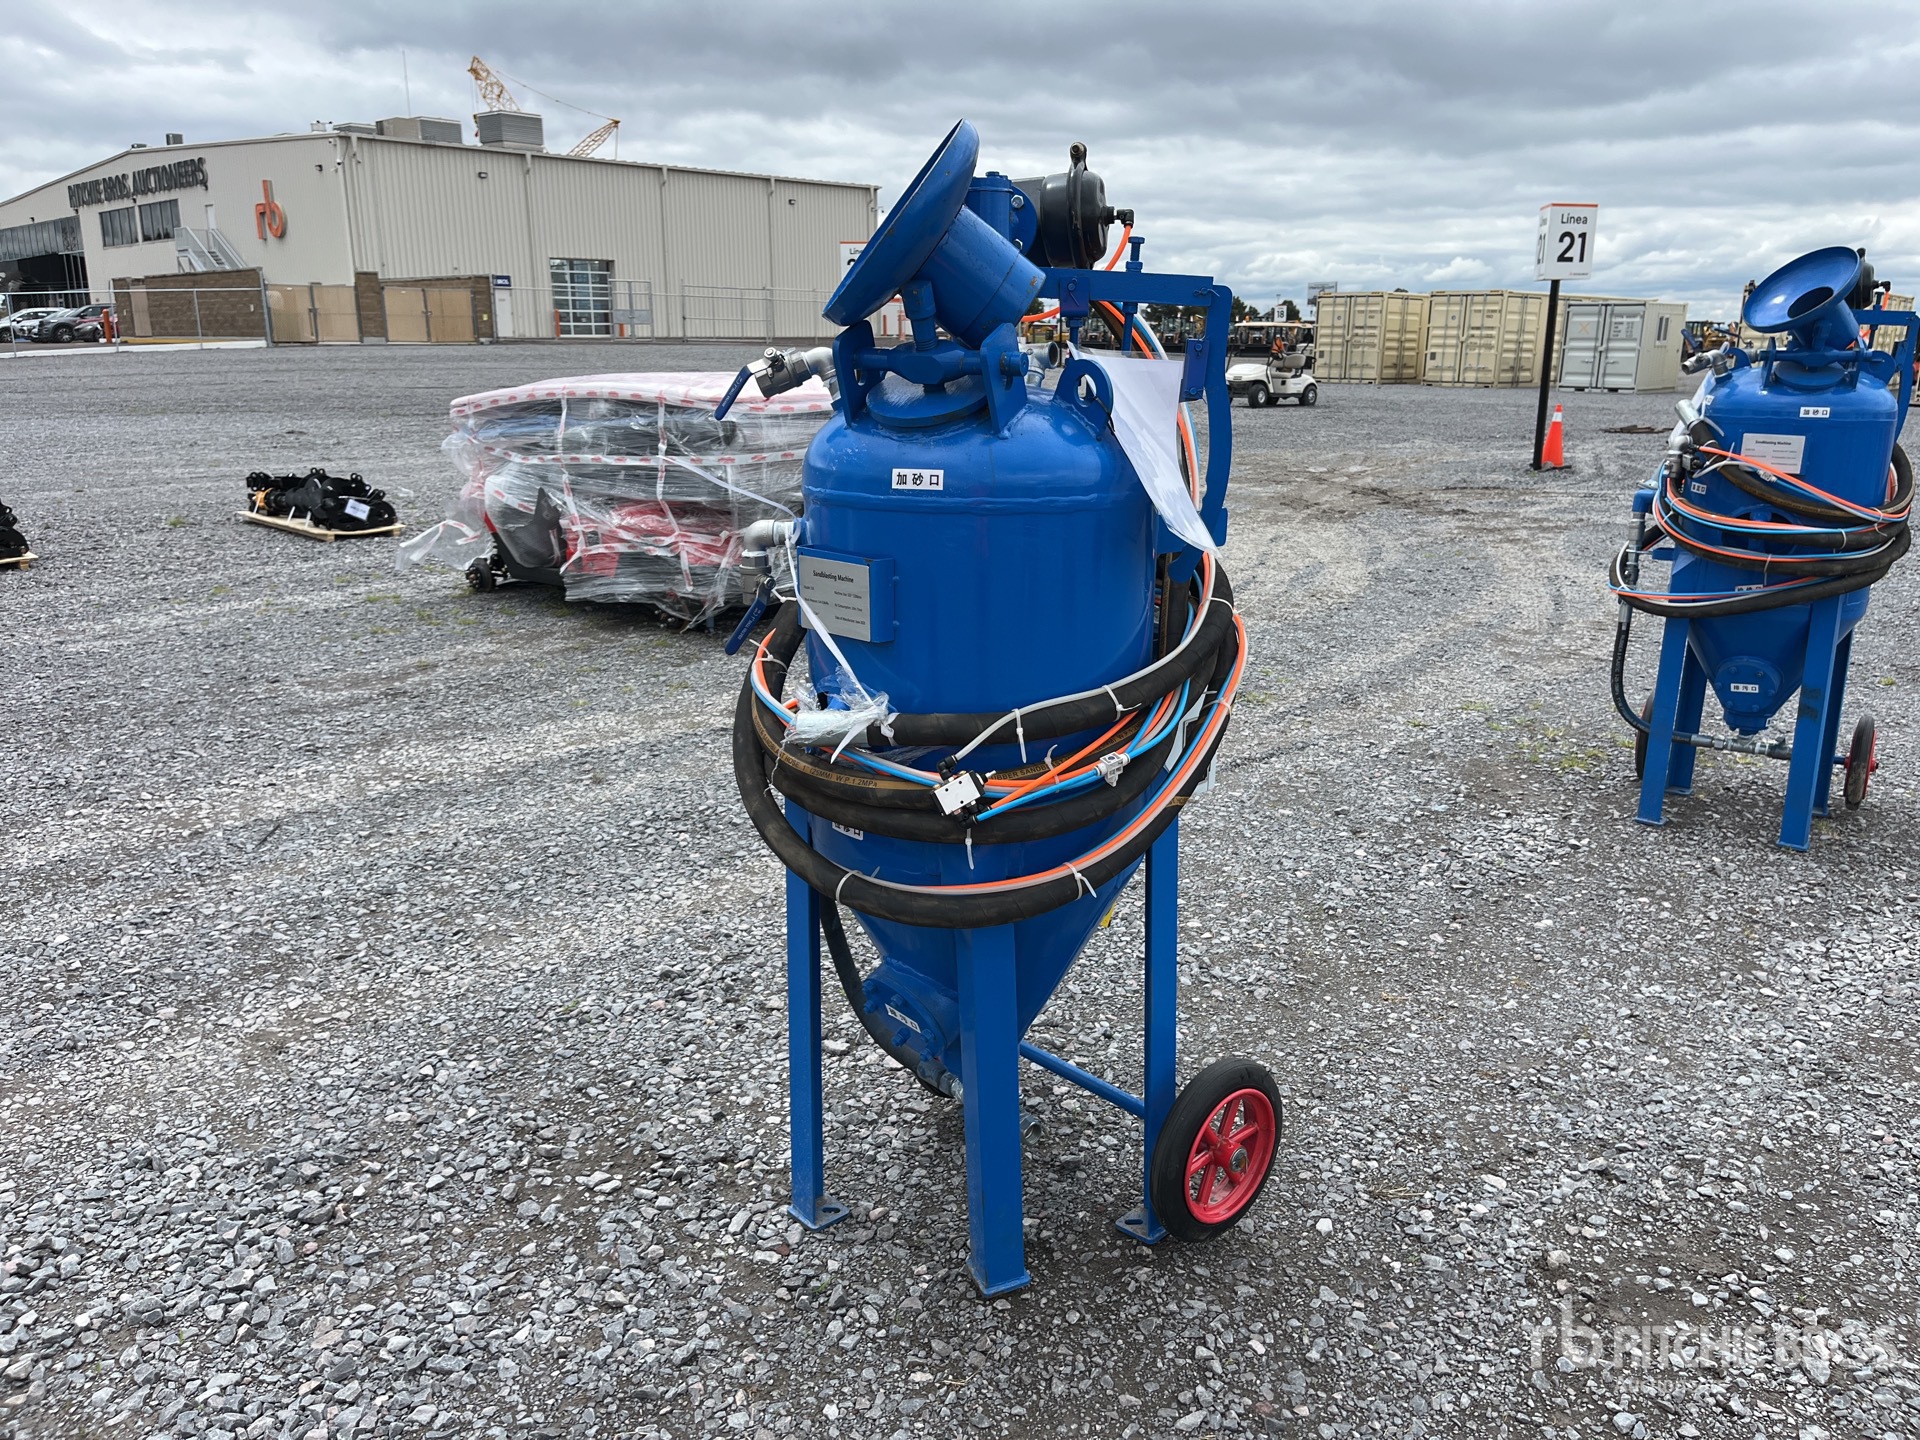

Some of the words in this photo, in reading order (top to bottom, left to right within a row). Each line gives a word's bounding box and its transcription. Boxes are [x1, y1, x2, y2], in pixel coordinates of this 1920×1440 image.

[132, 157, 208, 196] AUCTIONEERS
[1561, 213, 1588, 225] Línea
[1557, 231, 1587, 263] 21
[896, 472, 940, 487] 加砂口
[812, 569, 837, 581] Sandblasting
[837, 574, 854, 584] Machine
[784, 756, 801, 768] HOSE
